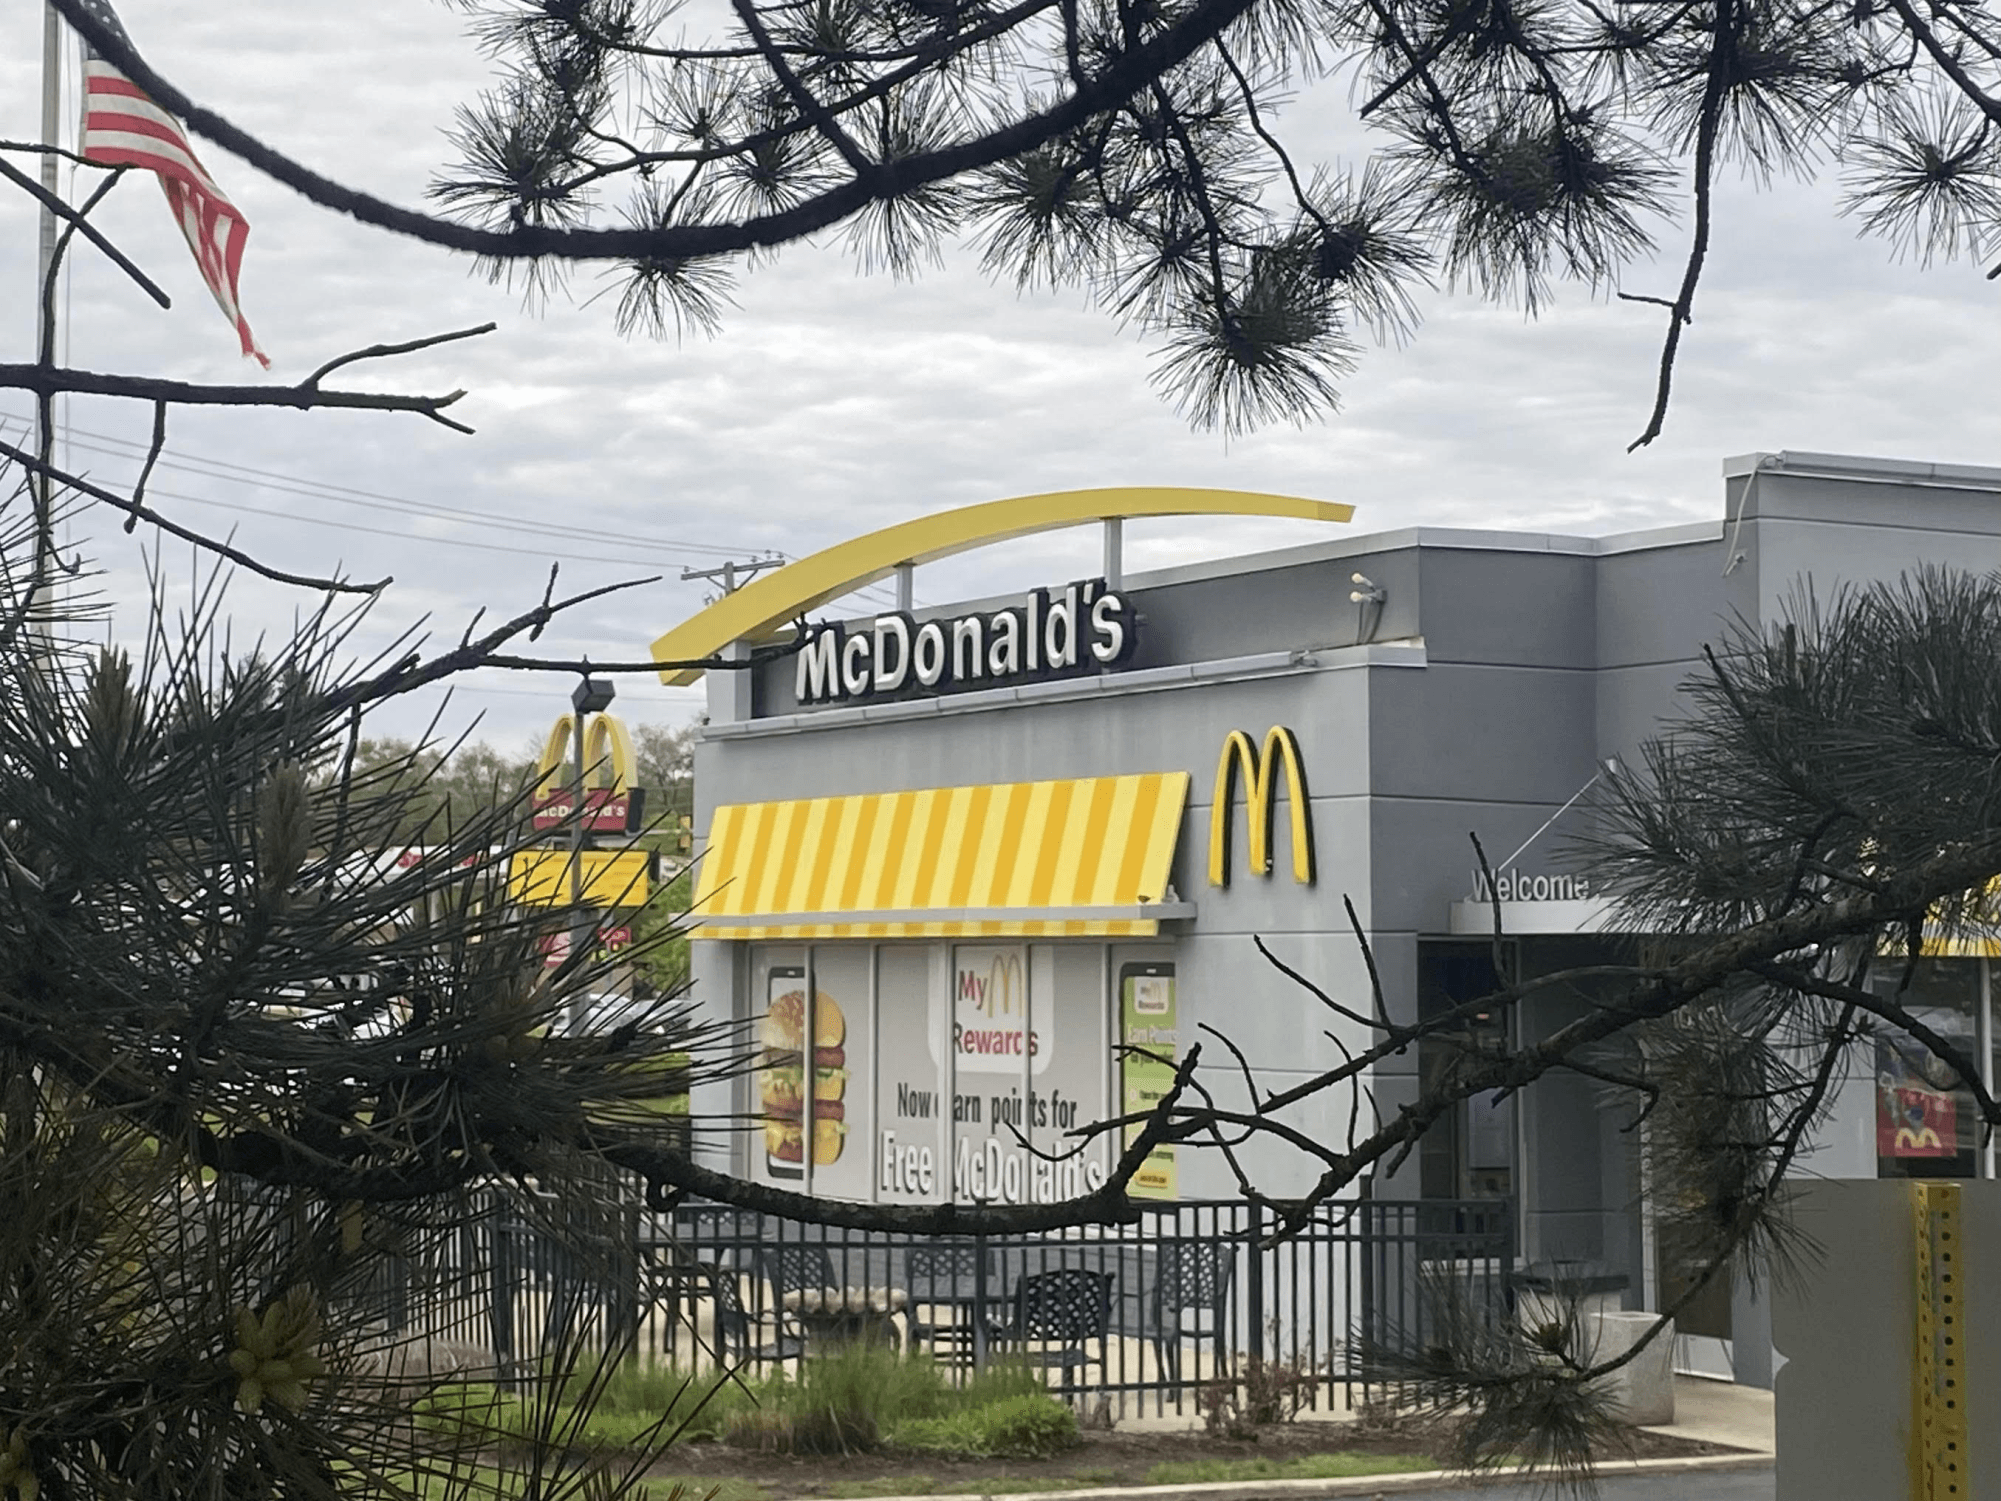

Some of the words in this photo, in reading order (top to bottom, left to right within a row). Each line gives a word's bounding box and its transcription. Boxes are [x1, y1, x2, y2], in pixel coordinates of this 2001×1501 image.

[795, 581, 1125, 702] McDonald's
[534, 804, 626, 818] cDd's
[1471, 867, 1590, 902] Welcome
[958, 970, 988, 1011] My
[897, 1081, 932, 1118] Now
[935, 1092, 982, 1123] arn
[1052, 1089, 1078, 1129] for
[881, 1130, 932, 1195] Free
